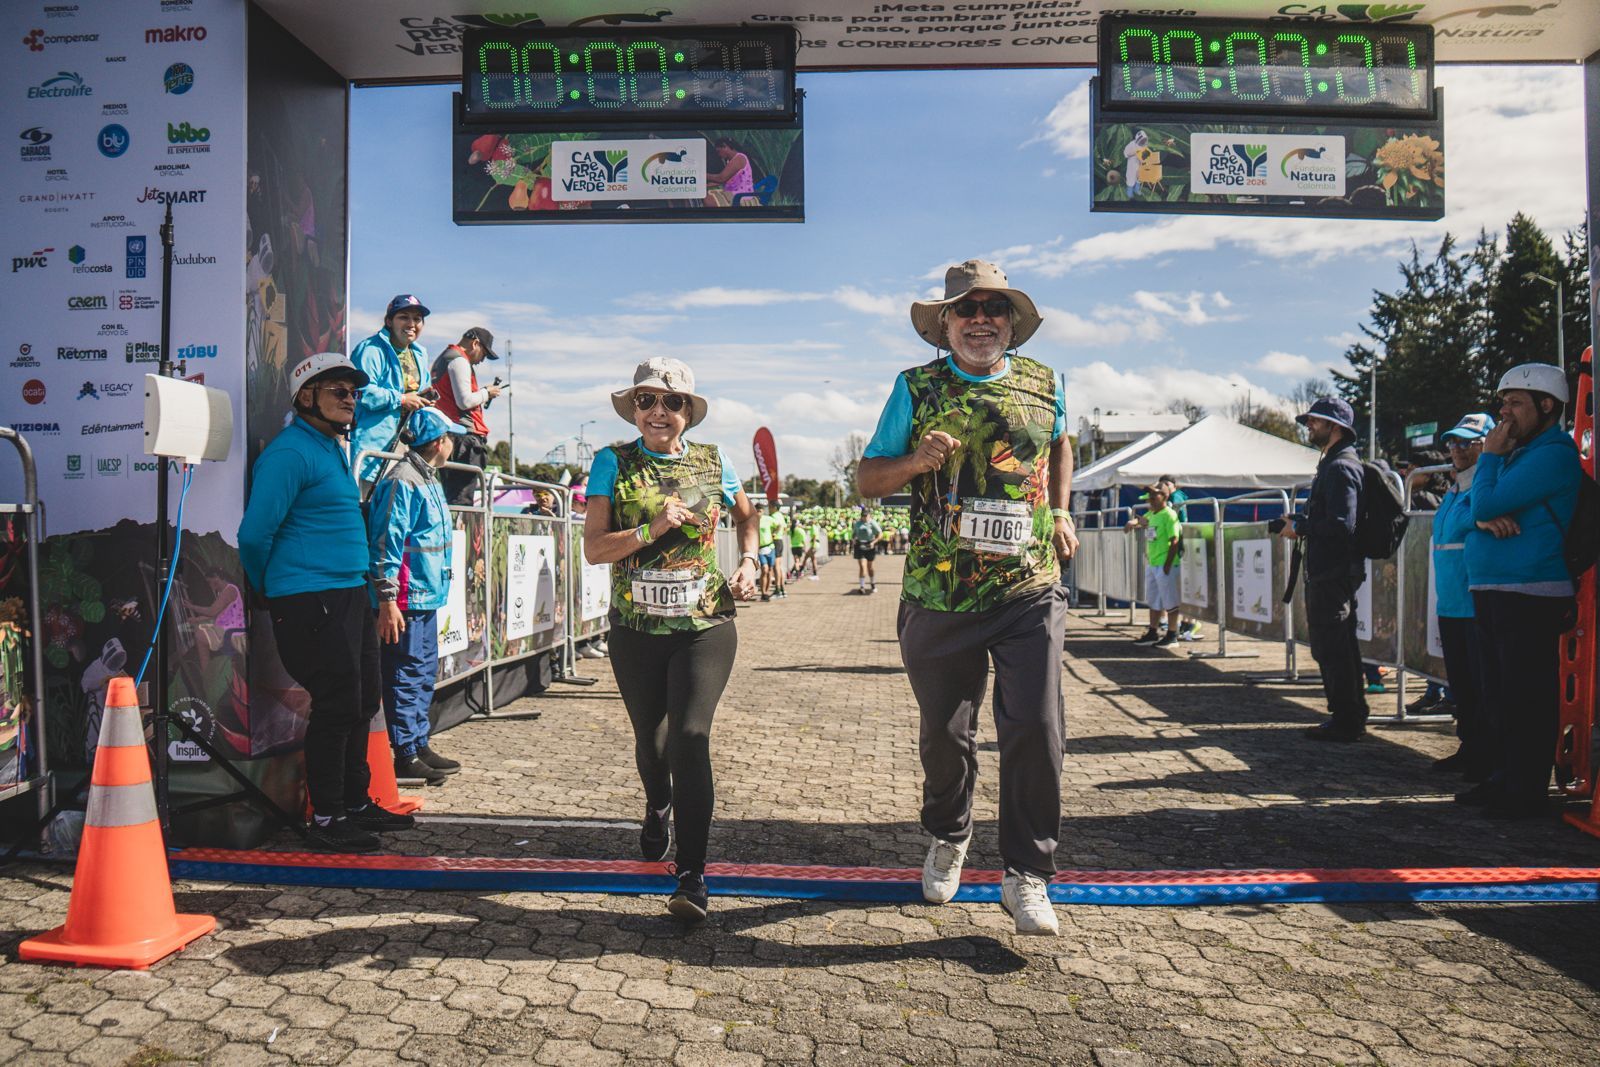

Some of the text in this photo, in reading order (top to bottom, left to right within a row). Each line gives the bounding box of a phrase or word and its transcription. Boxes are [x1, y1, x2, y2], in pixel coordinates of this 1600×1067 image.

[874, 1, 1080, 17] ¡Meta cumplida!
[751, 14, 844, 23] Gracias
[851, 15, 894, 24] por
[901, 13, 1006, 23] sembrar
[1013, 9, 1091, 22] futuro
[846, 18, 1098, 35] paso, porque juntos:
[43, 34, 100, 45] compensar
[145, 25, 207, 44] makro
[27, 85, 93, 99] Electrolife
[168, 121, 211, 144] bibo
[103, 133, 124, 149] blu
[20, 146, 52, 157] CARACOL
[176, 146, 211, 154] ESPECTADOR
[651, 175, 697, 186] Natura
[1246, 178, 1267, 186] 2026
[1290, 171, 1336, 182] Natura
[658, 185, 697, 193] Colombia
[1297, 182, 1337, 191] Colombia
[19, 192, 96, 203] GRAND HYATT
[137, 187, 207, 205] JetSMART
[12, 256, 48, 273] pwc
[172, 252, 217, 265] Audubon
[73, 264, 113, 274] refocosta
[68, 295, 108, 309] caem
[57, 347, 108, 361] Retorna
[135, 343, 161, 353] Pilas
[100, 383, 134, 393] LEGACY
[10, 423, 60, 433] VIZIONA
[97, 458, 122, 473] UAESP
[640, 585, 688, 605] 11061
